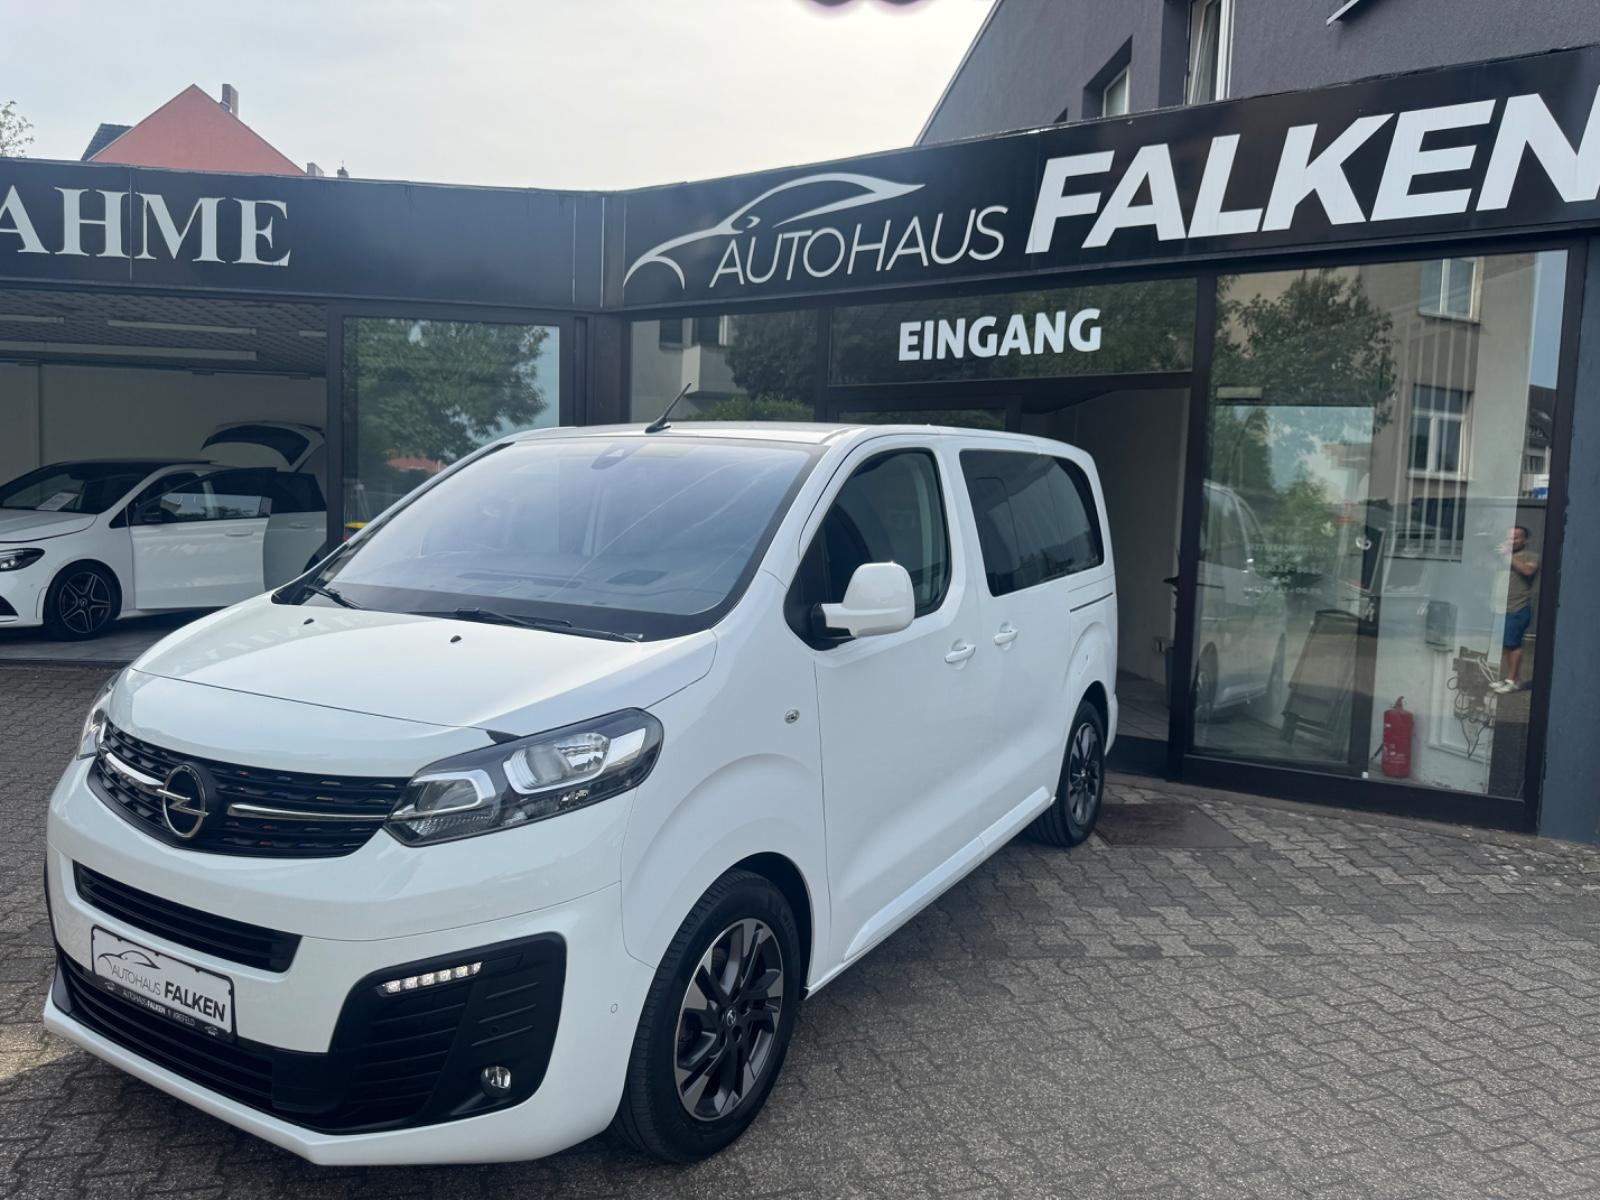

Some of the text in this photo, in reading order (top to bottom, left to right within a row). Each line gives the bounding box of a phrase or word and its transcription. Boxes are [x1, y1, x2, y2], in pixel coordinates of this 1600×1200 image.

[708, 84, 1600, 289] AUTOHAUS FALKEN
[0, 185, 291, 267] AHME
[898, 308, 1102, 361] EINGANG
[112, 964, 226, 1022] AUTOHAUS FALKEN
